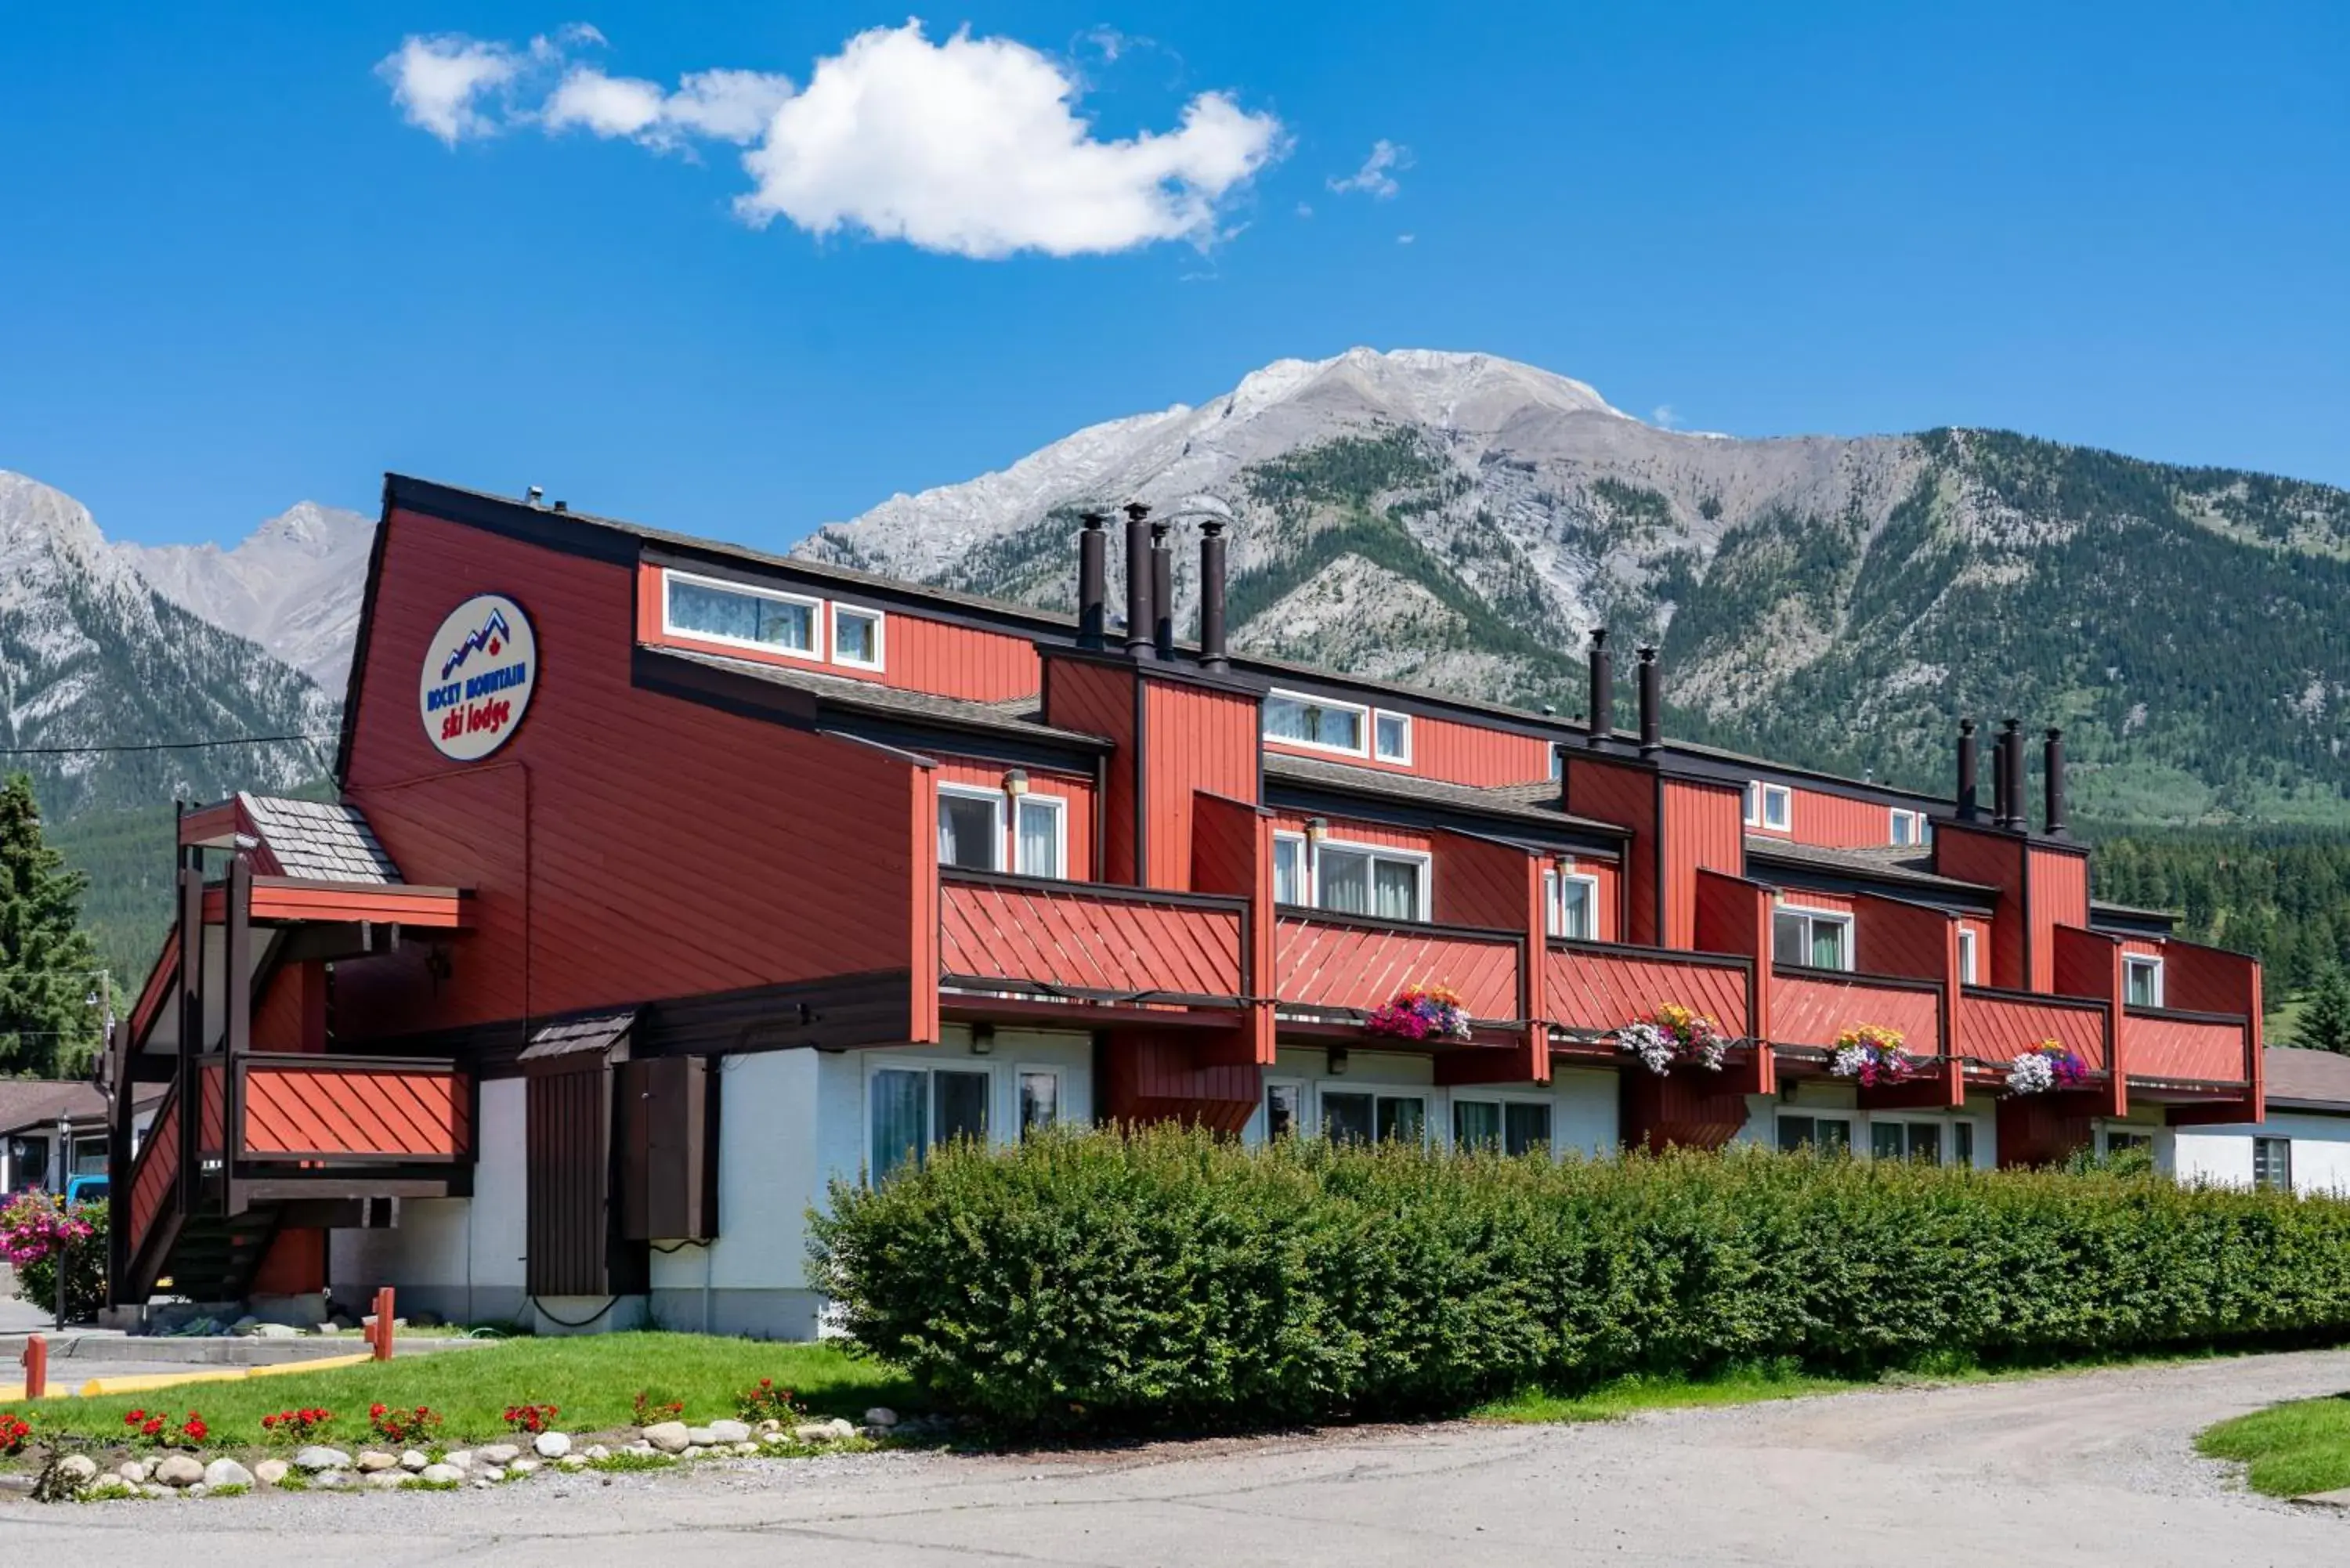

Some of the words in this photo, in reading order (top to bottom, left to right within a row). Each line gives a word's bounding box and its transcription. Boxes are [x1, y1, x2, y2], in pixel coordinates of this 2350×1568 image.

[428, 682, 461, 711] ROCKY
[466, 662, 526, 699] MOUNTAIN
[441, 706, 464, 740] ski
[467, 698, 511, 733] lodge
